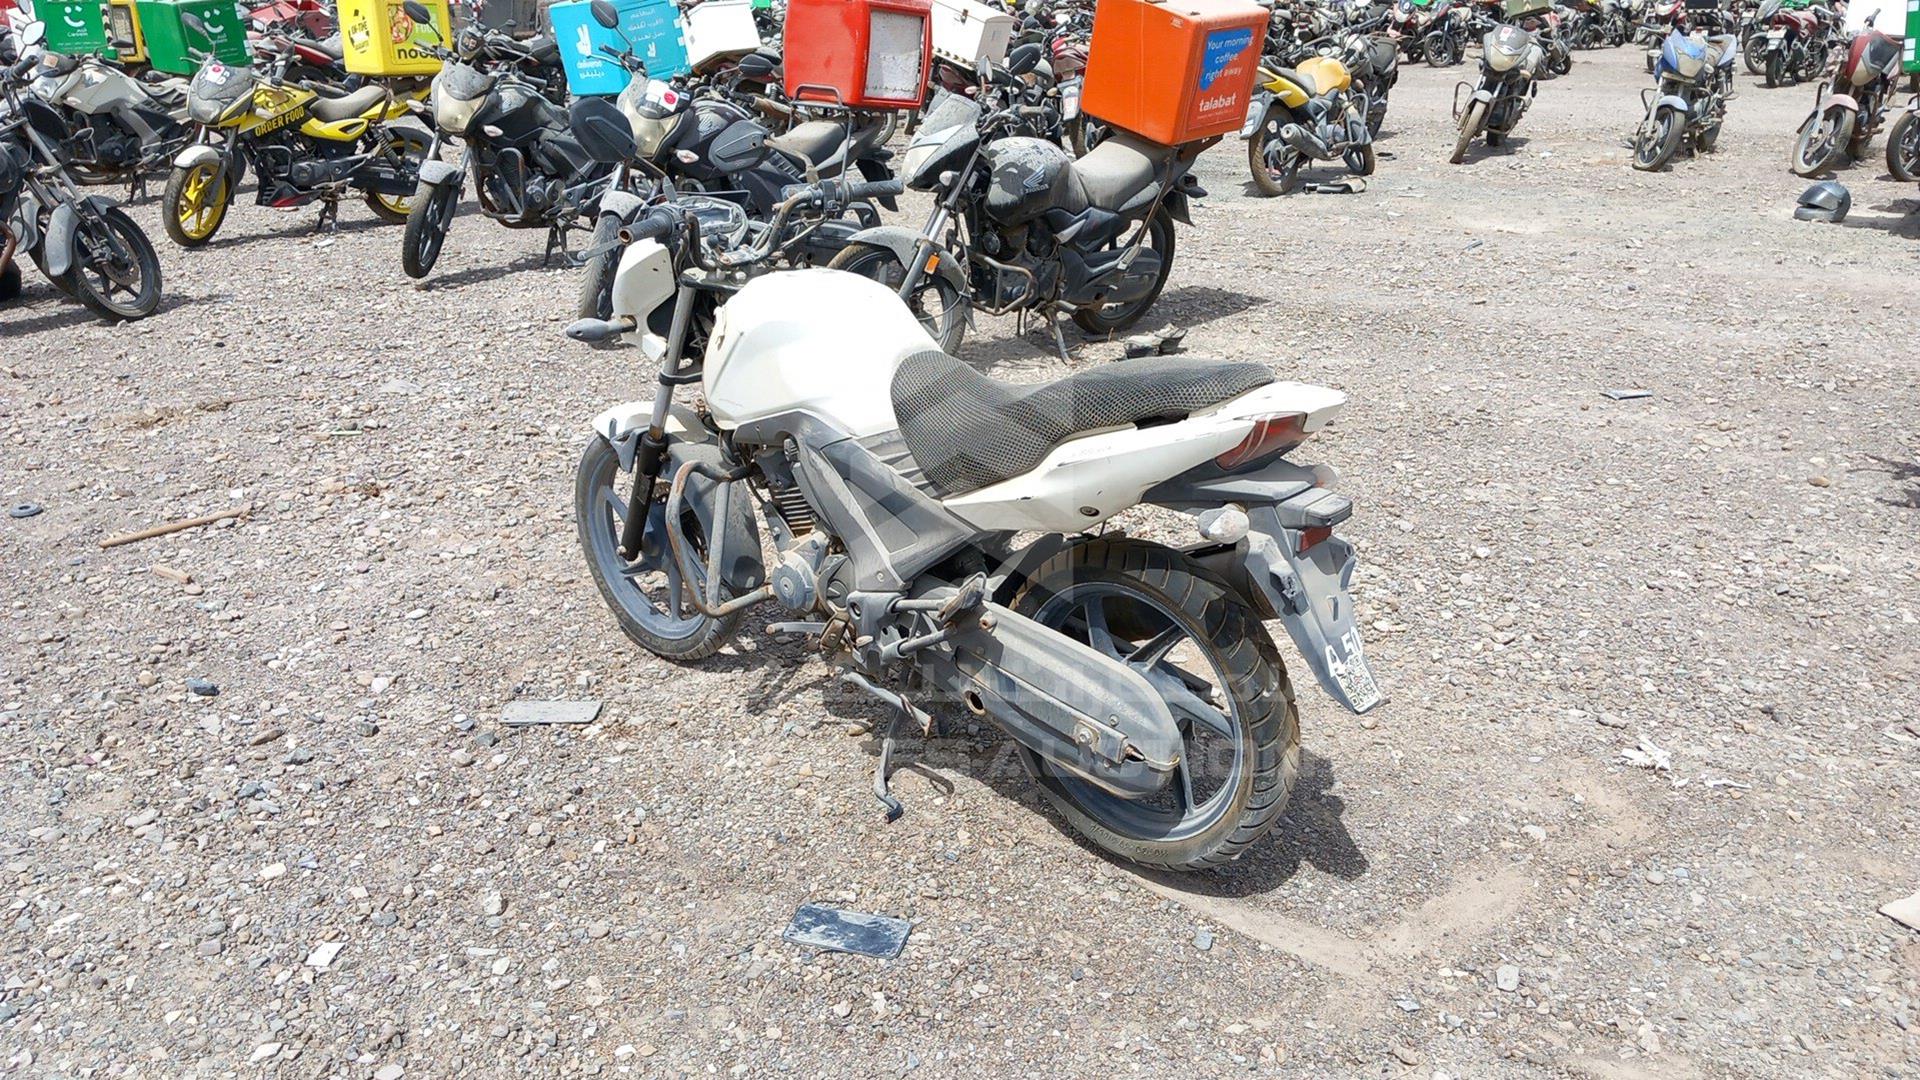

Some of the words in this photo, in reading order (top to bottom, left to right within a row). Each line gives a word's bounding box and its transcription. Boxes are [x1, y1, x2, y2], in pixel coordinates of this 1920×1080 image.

[1207, 39, 1224, 50] Your
[1224, 35, 1254, 48] morning
[1215, 52, 1239, 64] coffee
[1204, 69, 1223, 82] right
[1223, 66, 1243, 77] away
[1199, 92, 1237, 112] talabat
[255, 116, 285, 137] ORDER
[284, 106, 305, 125] FOOD
